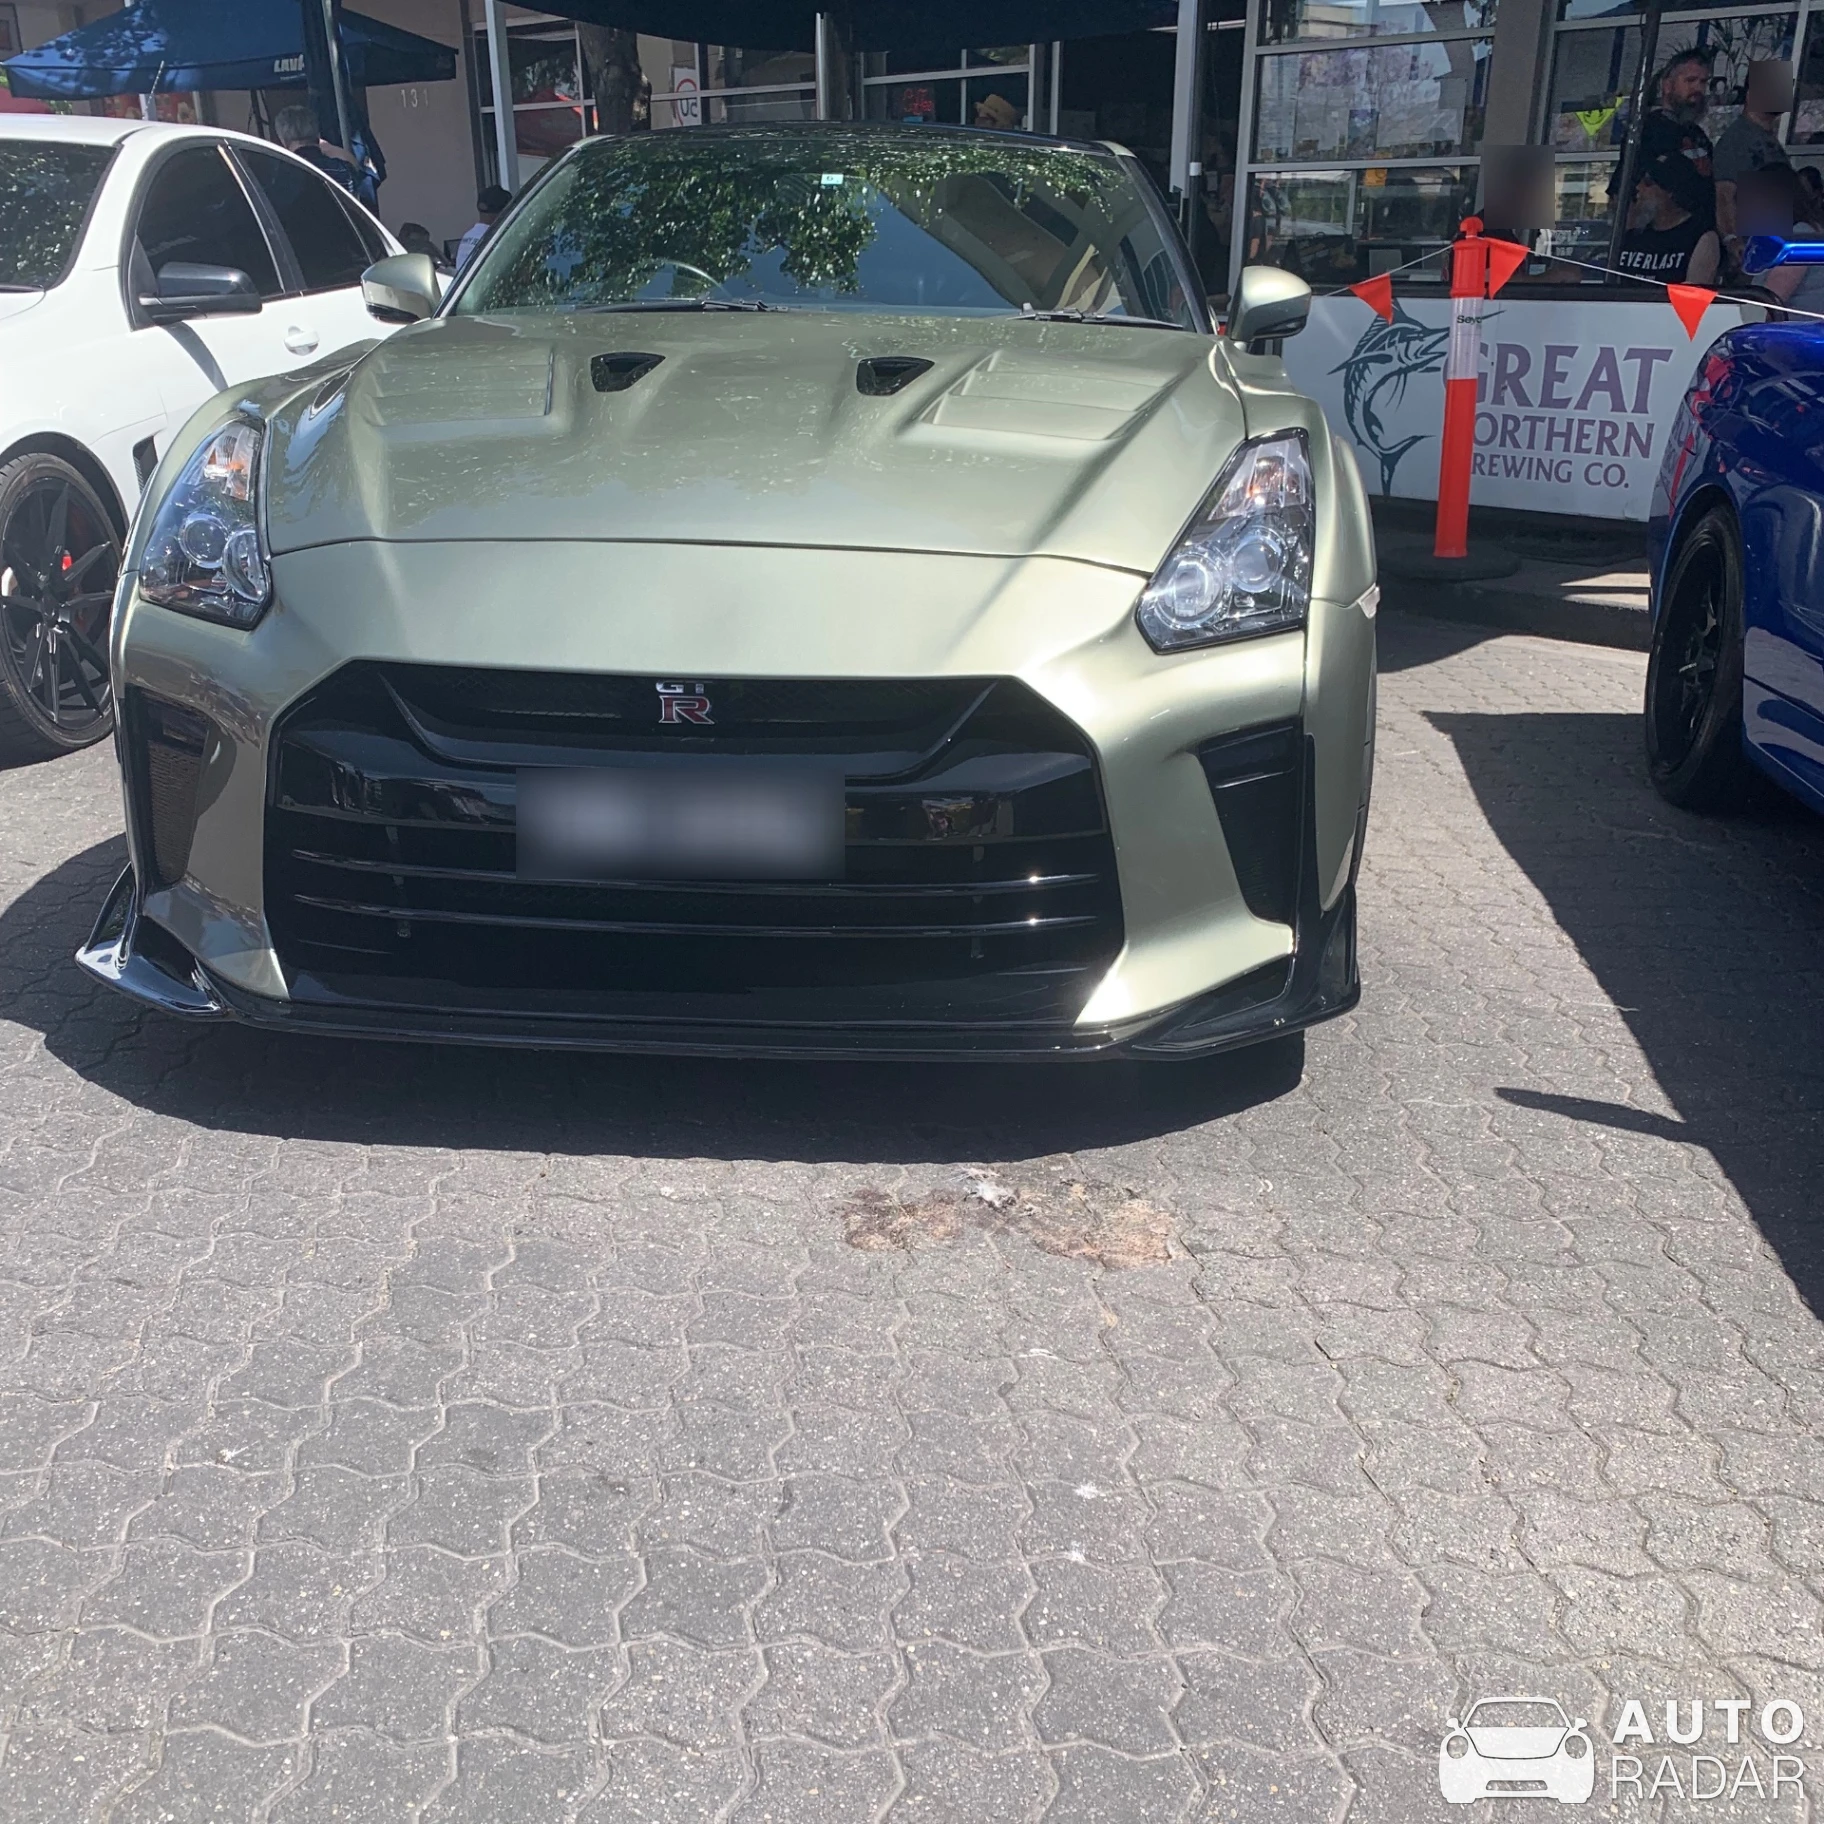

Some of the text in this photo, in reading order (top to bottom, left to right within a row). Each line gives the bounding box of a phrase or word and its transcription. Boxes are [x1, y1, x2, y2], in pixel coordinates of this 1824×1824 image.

[400, 88, 429, 108] 131
[1619, 250, 1685, 270] EVERLAST
[1473, 411, 1655, 459] ORTHERN
[1471, 452, 1629, 489] REWING CO.
